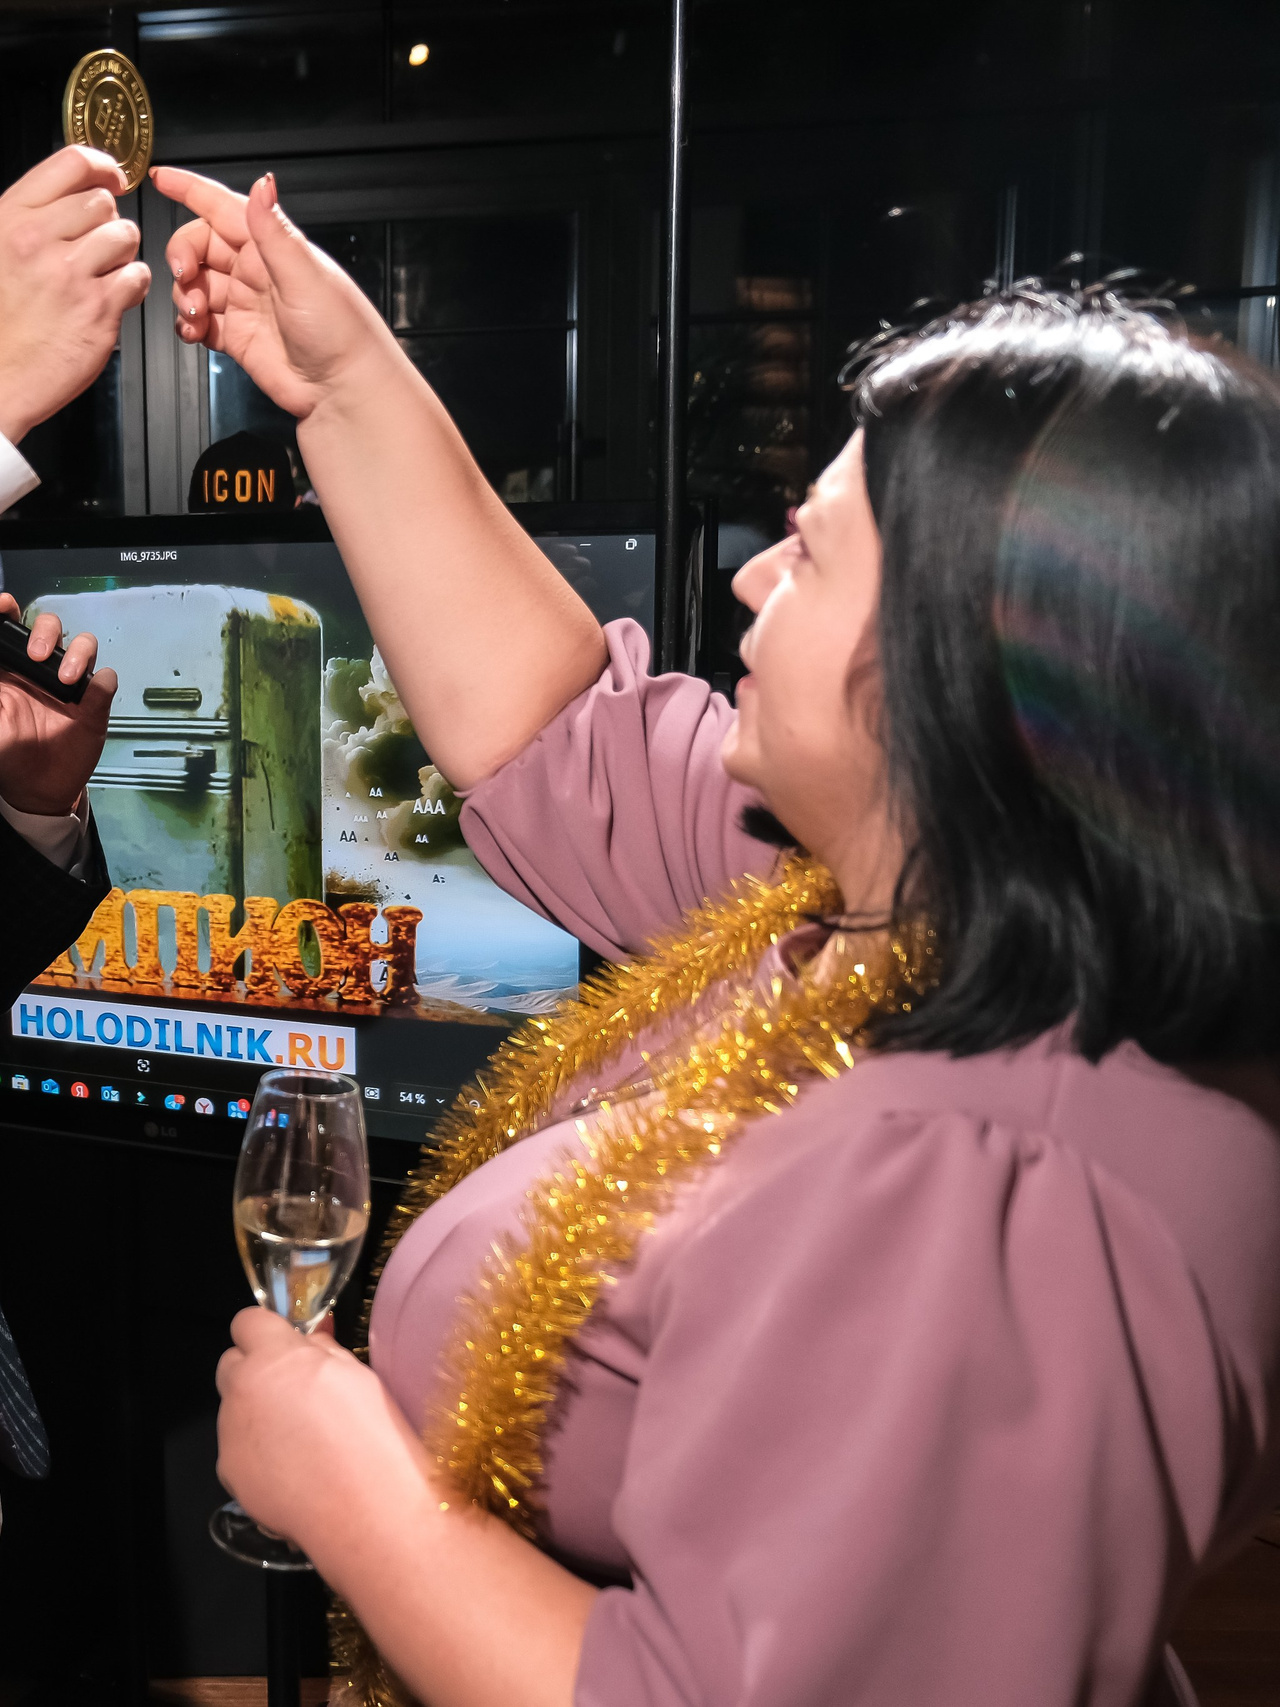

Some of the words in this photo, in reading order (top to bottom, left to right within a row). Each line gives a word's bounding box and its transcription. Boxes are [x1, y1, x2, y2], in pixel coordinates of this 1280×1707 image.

[203, 469, 275, 503] ICON
[369, 787, 383, 797] AA
[413, 799, 445, 815] AAA
[340, 830, 357, 842] AA
[415, 834, 429, 843] AA
[384, 852, 399, 861] AA
[20, 1002, 346, 1071] HOLODILNIK.RU
[399, 1091, 413, 1103] 54
[415, 1093, 426, 1105] %
[161, 1125, 177, 1138] LG
